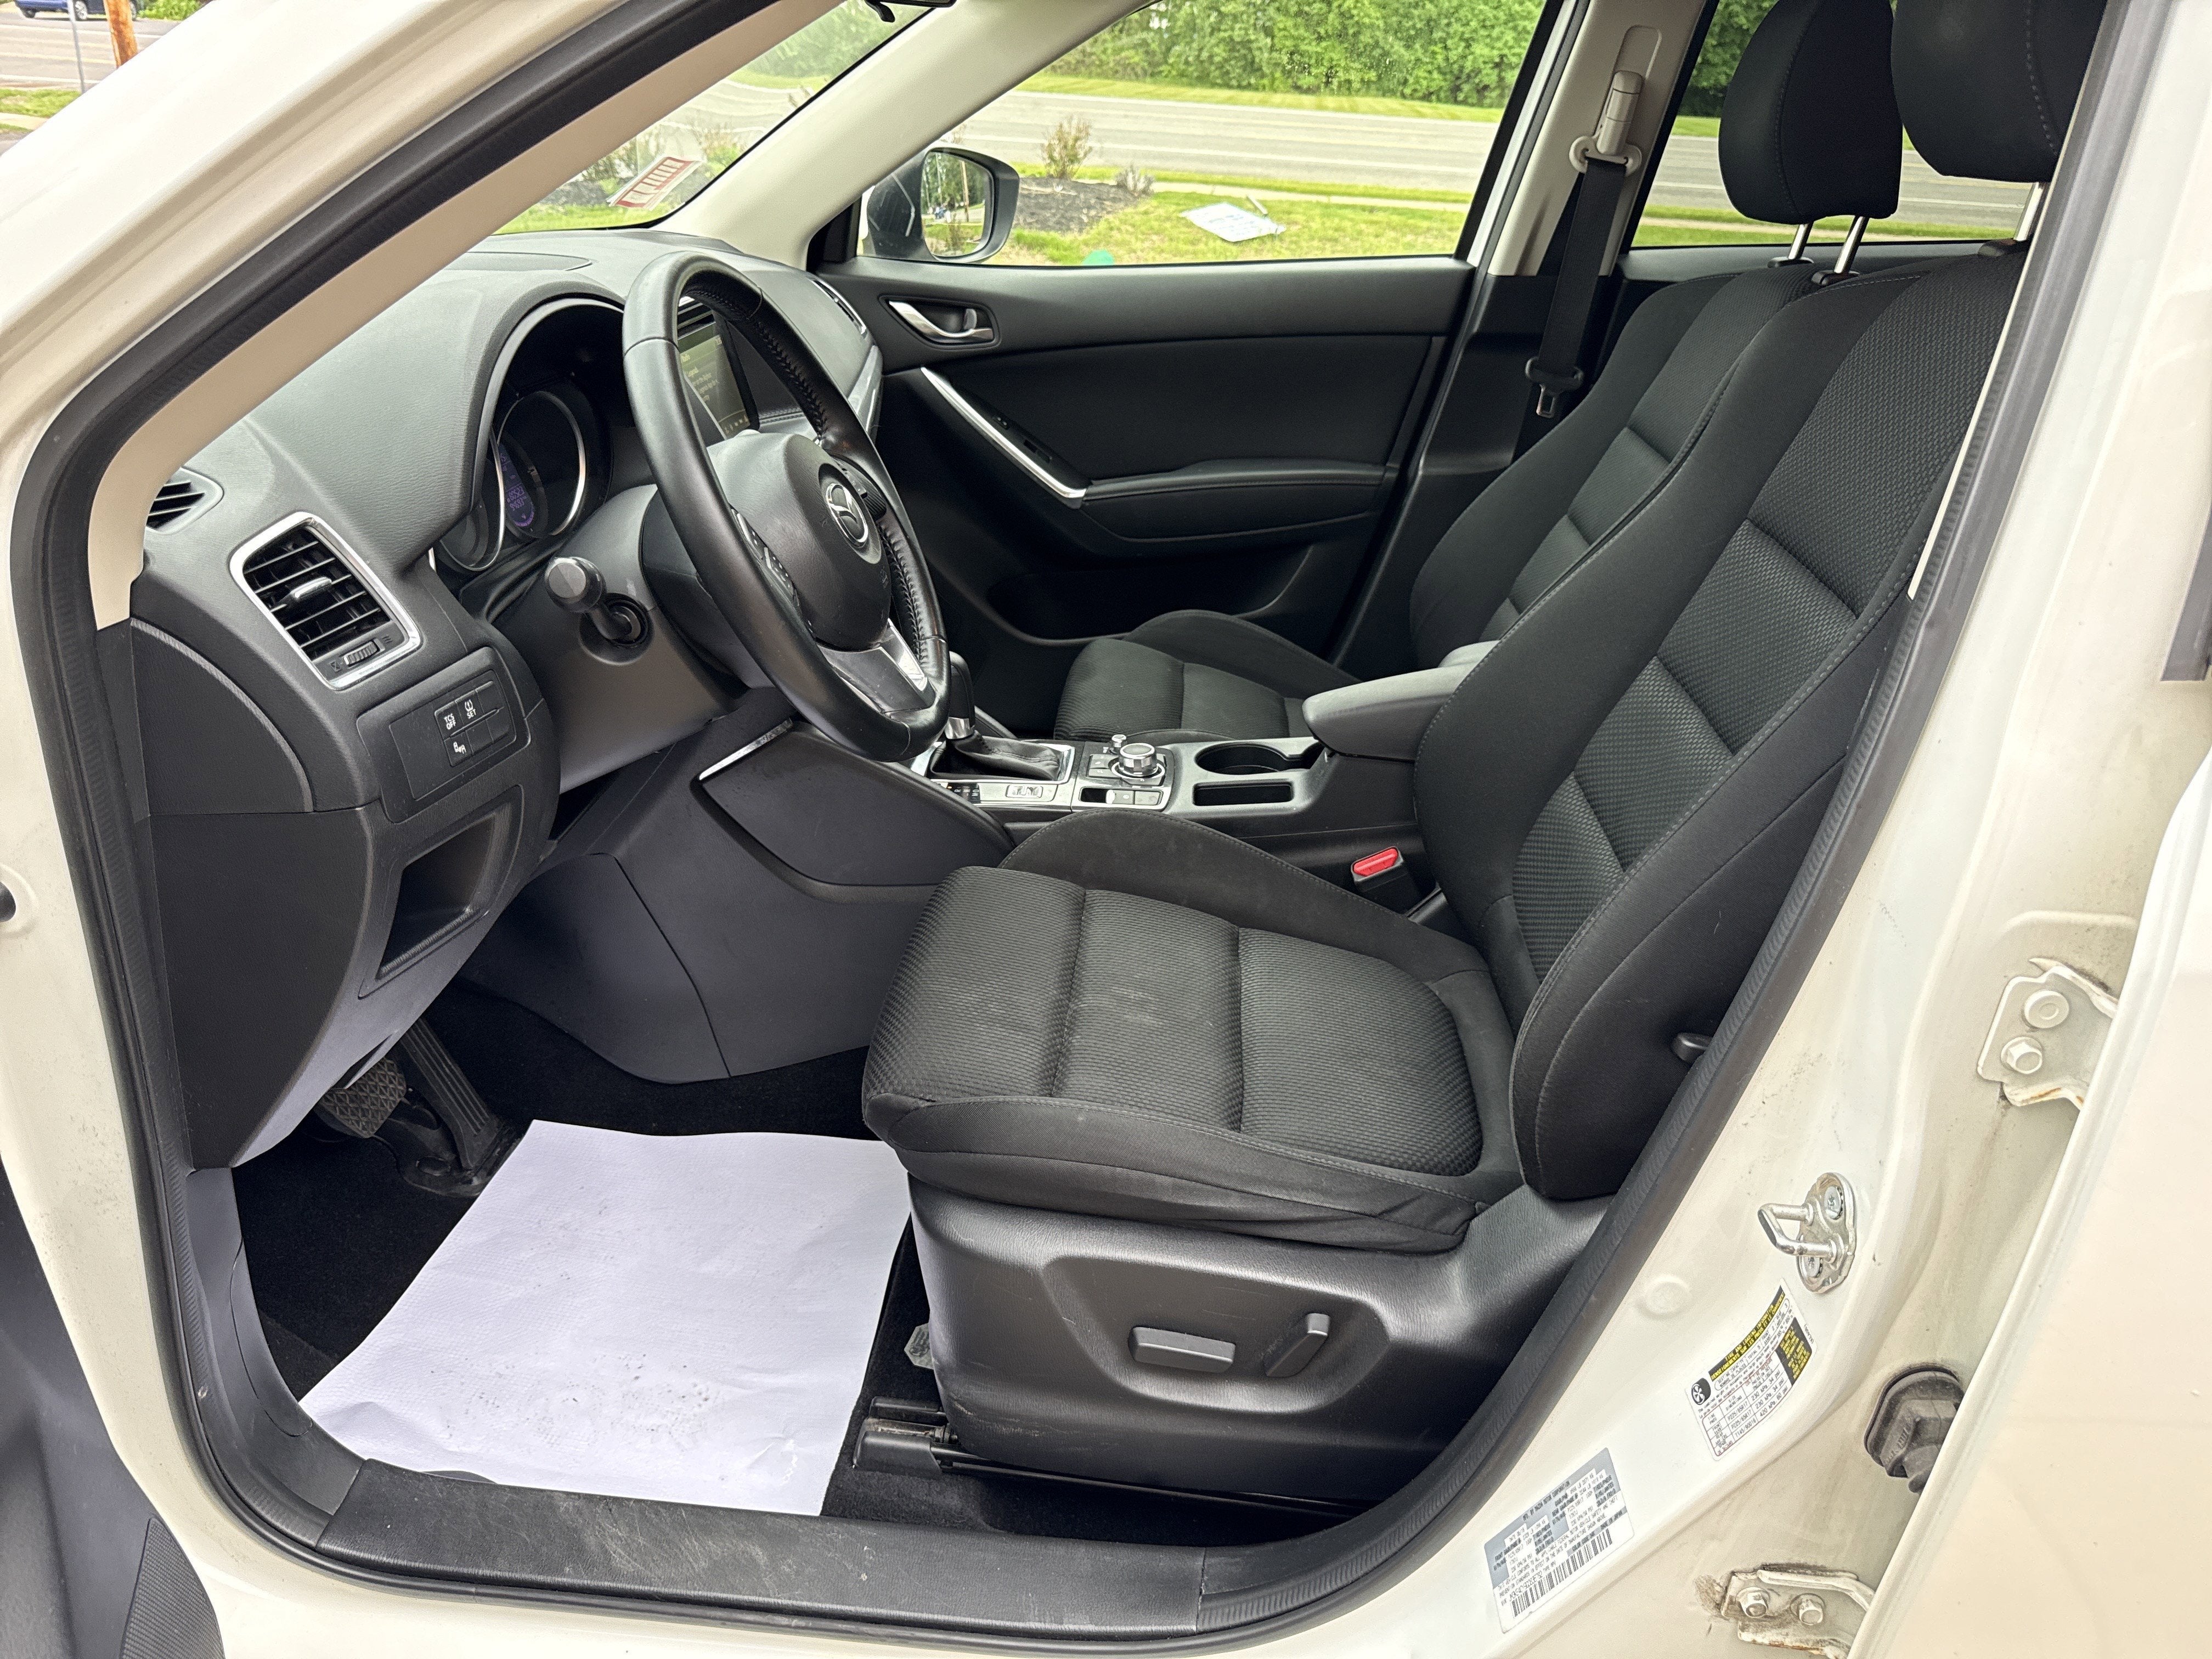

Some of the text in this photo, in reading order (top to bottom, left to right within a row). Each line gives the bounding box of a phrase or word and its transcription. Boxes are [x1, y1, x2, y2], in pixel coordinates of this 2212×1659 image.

[444, 713, 455, 723] TCS
[467, 709, 476, 719] SET
[446, 720, 456, 730] OFF
[1751, 1390, 1759, 1401] 230
[1768, 1375, 1774, 1385] 34
[1755, 1398, 1764, 1409] 230
[1772, 1384, 1778, 1392] 34
[1727, 1400, 1748, 1421] P225/65R17
[1759, 1407, 1768, 1418] 420
[1776, 1391, 1782, 1401] 60
[1731, 1409, 1752, 1430] P225/65R17
